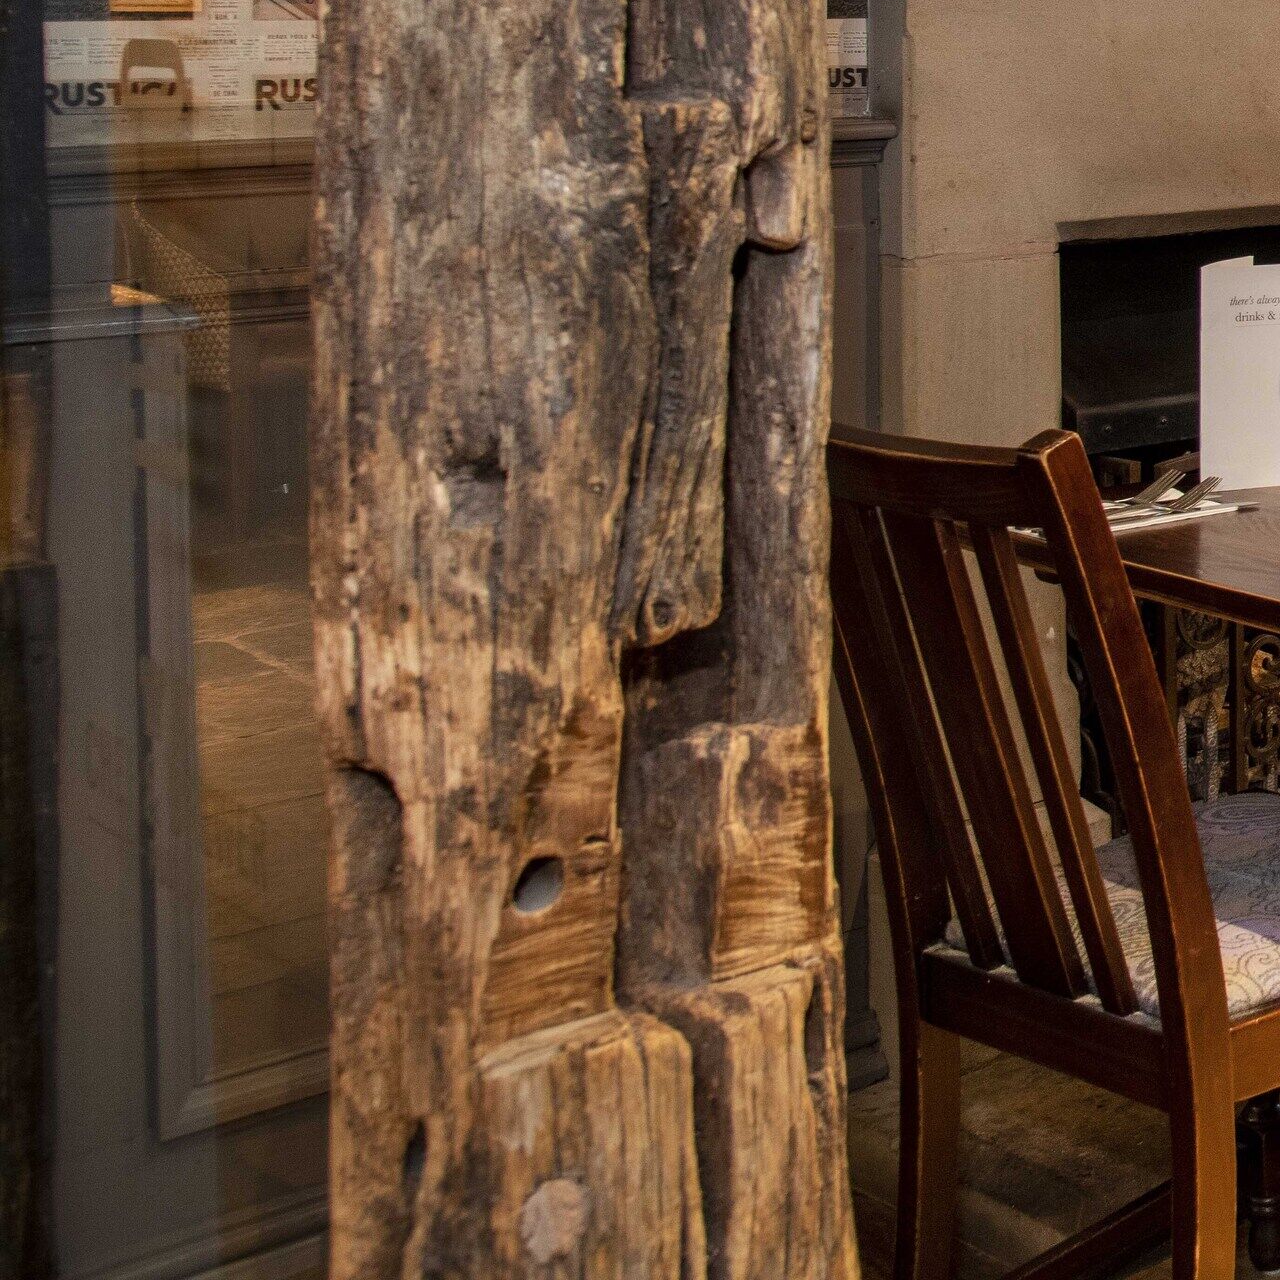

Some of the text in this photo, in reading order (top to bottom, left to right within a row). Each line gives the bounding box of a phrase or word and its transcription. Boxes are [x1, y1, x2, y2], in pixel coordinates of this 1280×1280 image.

[1230, 296, 1254, 306] there's
[1235, 311, 1264, 322] drinks
[1268, 311, 1275, 320] &
